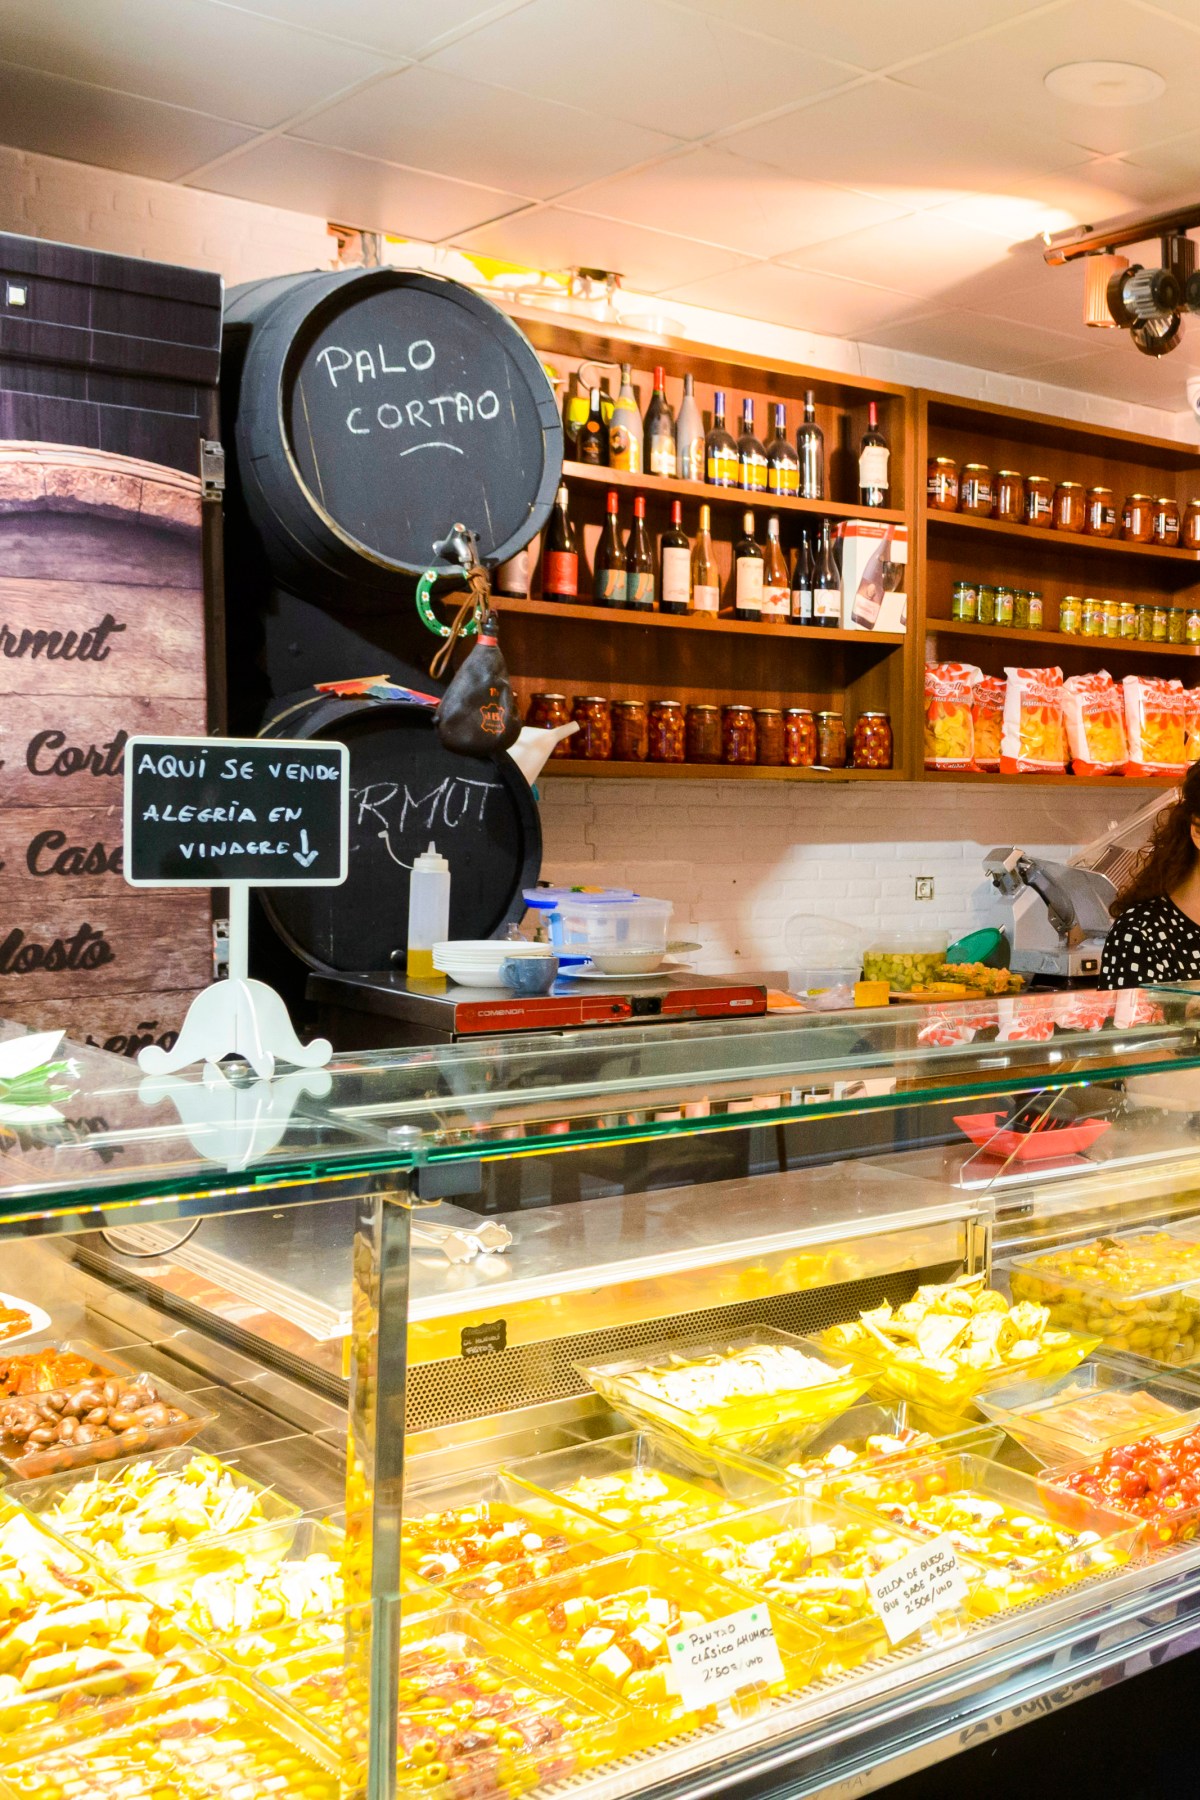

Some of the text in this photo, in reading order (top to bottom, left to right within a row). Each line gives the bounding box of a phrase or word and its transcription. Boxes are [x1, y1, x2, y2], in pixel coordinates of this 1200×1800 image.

[316, 339, 436, 388] PALO
[346, 390, 500, 434] CORTAO
[0, 613, 127, 662] rmut
[26, 729, 126, 778] Cort
[219, 758, 255, 780] SE
[268, 762, 341, 783] VENDE
[142, 800, 303, 823] ALEGRÍA EN
[350, 776, 504, 833] RMUT
[25, 829, 125, 877] Case
[179, 840, 291, 860] VINAGRE
[477, 1008, 525, 1017] COMENDA
[877, 1552, 945, 1600] GILDA DE QUESO
[882, 1598, 900, 1614] QUE
[903, 1579, 926, 1599] SABE
[929, 1572, 937, 1582] A
